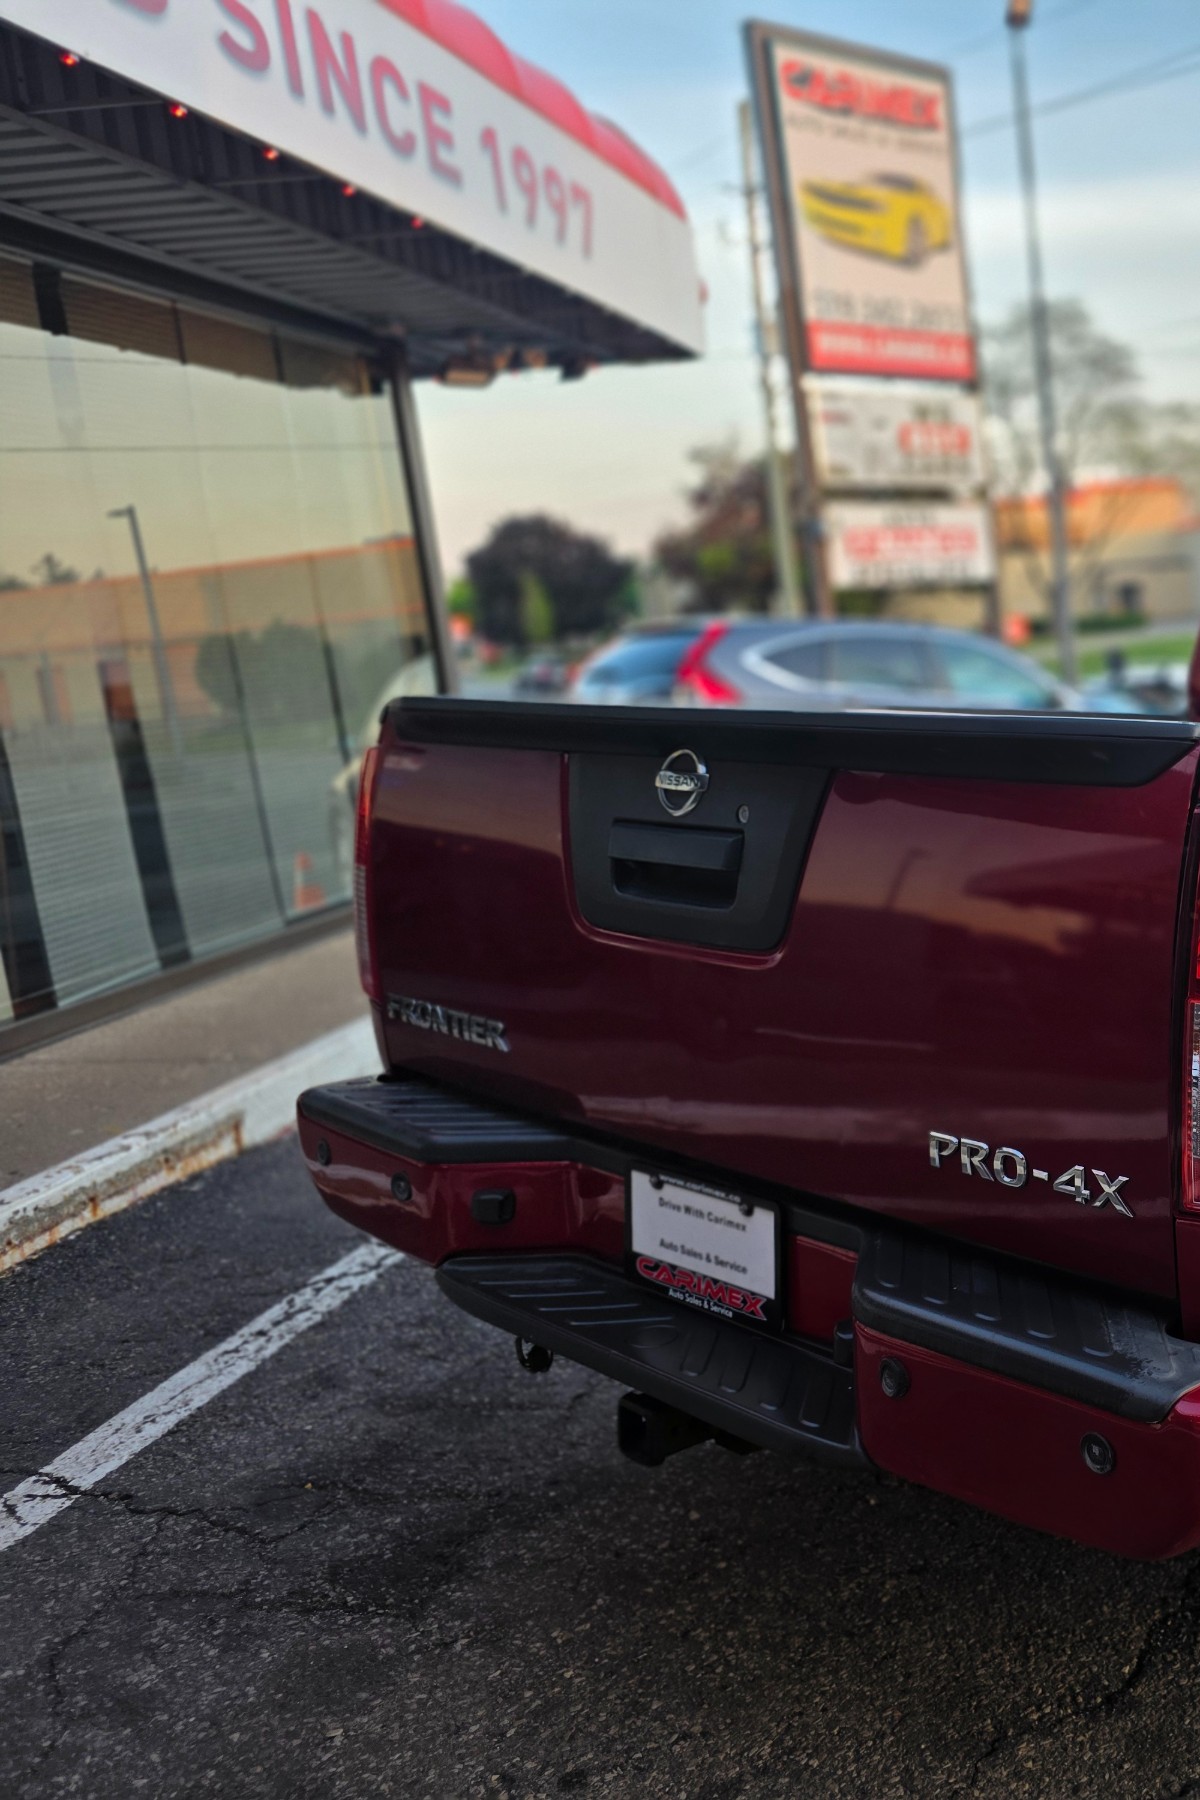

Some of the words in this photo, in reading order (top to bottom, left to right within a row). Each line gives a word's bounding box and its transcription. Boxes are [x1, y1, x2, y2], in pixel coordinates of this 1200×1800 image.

[217, 0, 462, 187] SINCE
[480, 126, 596, 259] 1997
[387, 992, 511, 1052] FRONTIER
[929, 1131, 1134, 1218] PRO-4X
[659, 1197, 682, 1213] Drive
[684, 1205, 705, 1220] With
[707, 1211, 747, 1232] Carimex
[659, 1238, 679, 1252] Auto
[680, 1244, 703, 1261] Sales
[705, 1252, 712, 1263] &
[714, 1255, 748, 1275] Service
[635, 1255, 768, 1321] CARIMEX
[668, 1288, 685, 1301] Auto
[685, 1293, 703, 1308] Sales
[703, 1300, 709, 1309] &
[710, 1302, 734, 1319] Service
